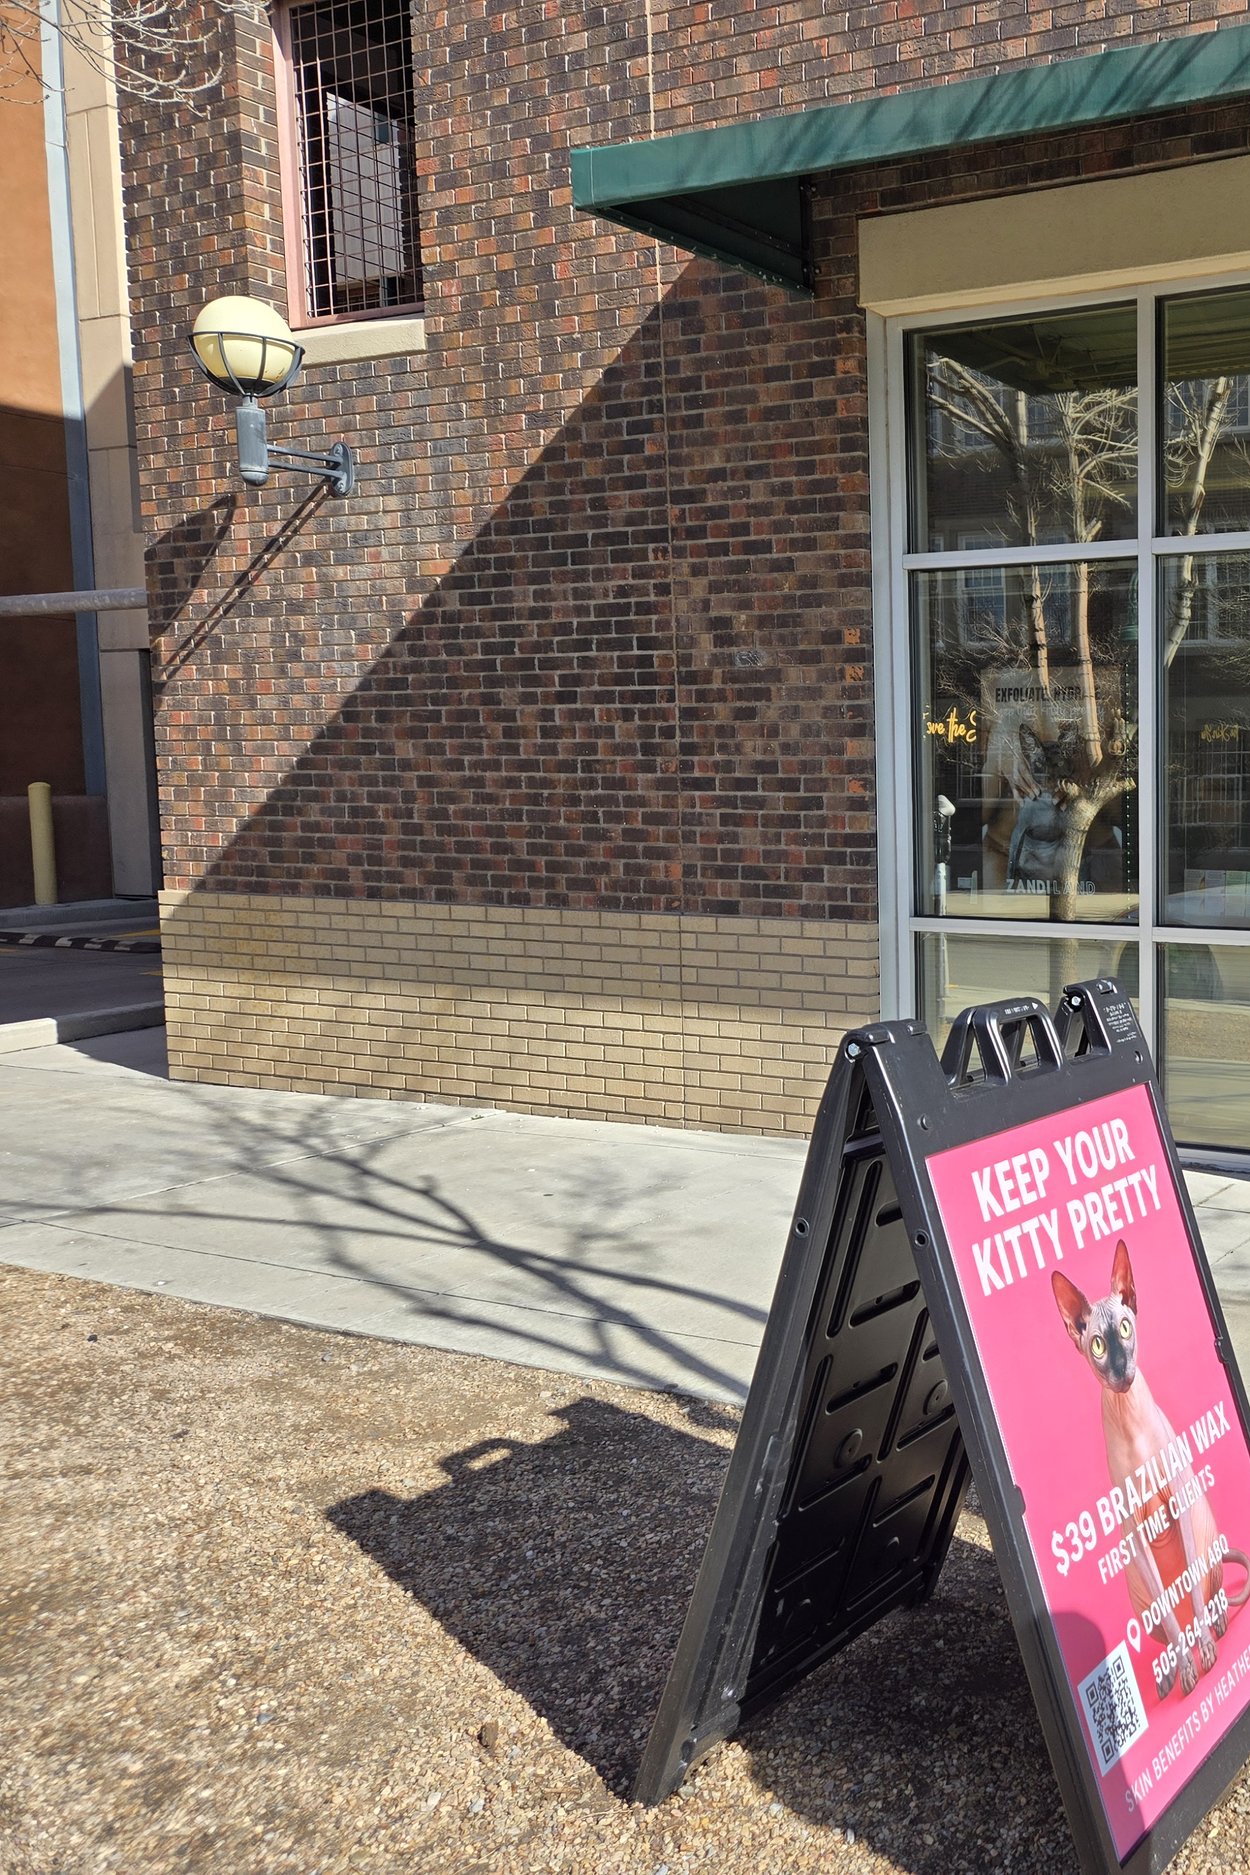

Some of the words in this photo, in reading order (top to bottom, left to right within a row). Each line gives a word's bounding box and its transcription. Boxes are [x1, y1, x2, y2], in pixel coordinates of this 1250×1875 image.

[971, 1148, 1050, 1222] KEEP
[1053, 1118, 1135, 1185] YOUR
[971, 1208, 1064, 1297] KITTY
[1067, 1164, 1161, 1250] PRETTY
[1051, 1510, 1097, 1576] $39
[1096, 1436, 1193, 1536] BRAZILIAN
[1190, 1401, 1231, 1455] WAX
[1098, 1531, 1137, 1584] FIRST
[1137, 1506, 1170, 1547] TIME
[1169, 1464, 1215, 1520] CLIENTS
[1142, 1554, 1209, 1634] DOWNTOWN
[1151, 1588, 1229, 1684] 505-264-4218
[1125, 1767, 1153, 1812] SKIN
[1152, 1710, 1201, 1779] BENEFITS
[1200, 1696, 1216, 1723] BY
